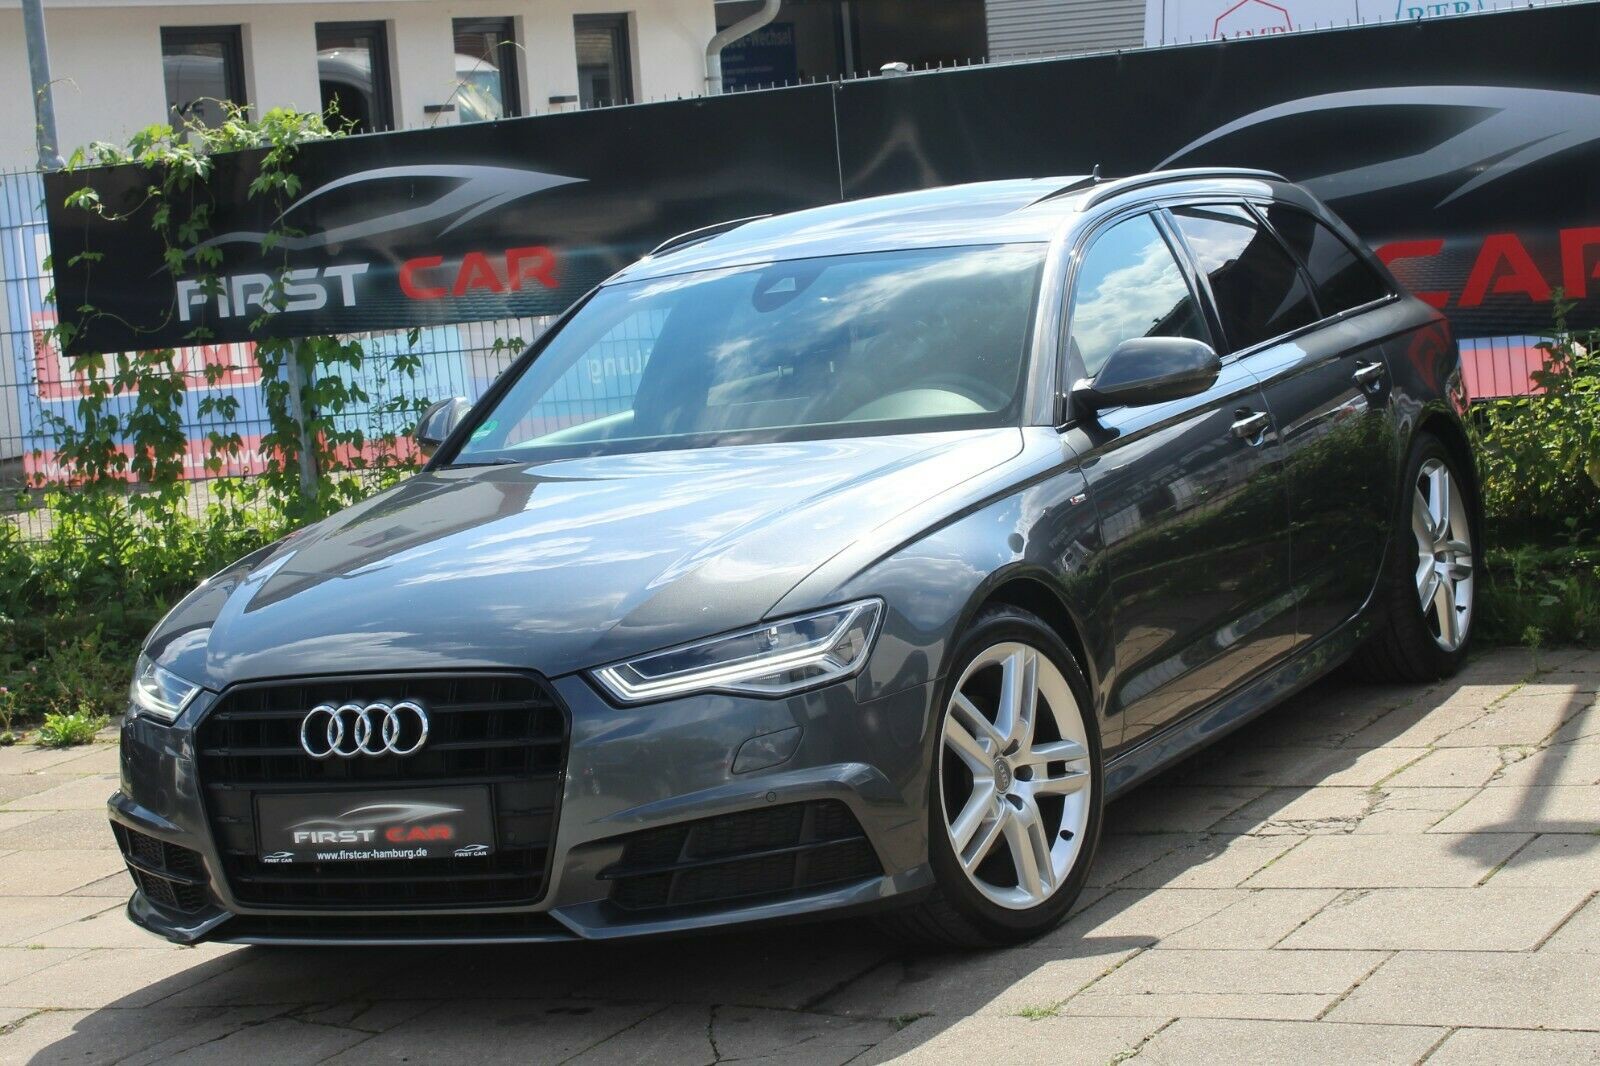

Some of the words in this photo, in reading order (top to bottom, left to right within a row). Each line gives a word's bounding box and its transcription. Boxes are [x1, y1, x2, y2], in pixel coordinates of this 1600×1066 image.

[176, 262, 370, 322] FIRST
[399, 245, 560, 301] CAR
[293, 829, 376, 844] FIRST
[386, 825, 452, 843] CAR
[316, 848, 428, 860] www.firstcar-hamburg.de
